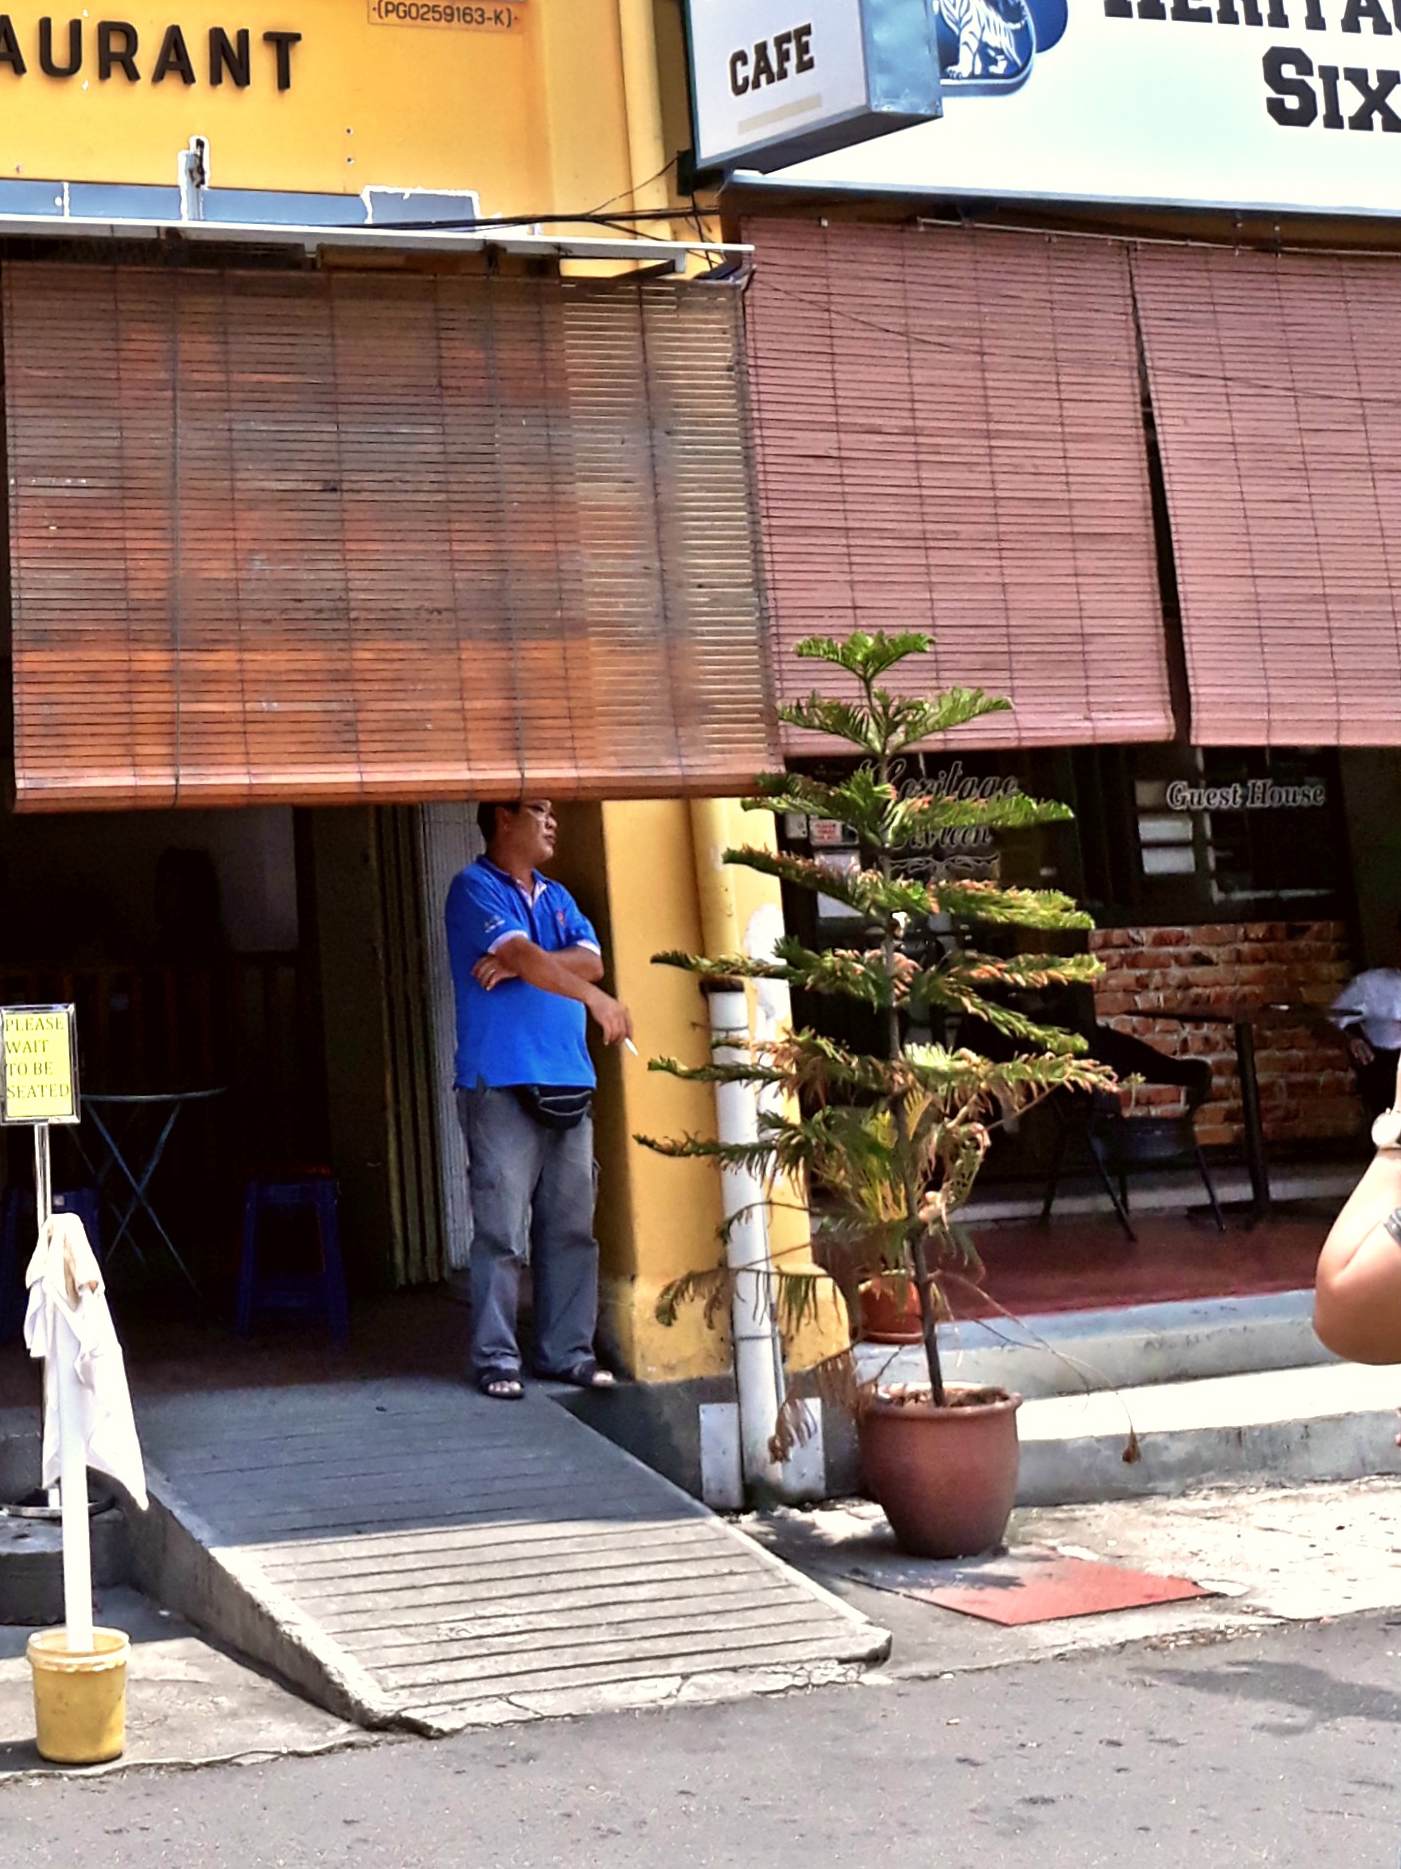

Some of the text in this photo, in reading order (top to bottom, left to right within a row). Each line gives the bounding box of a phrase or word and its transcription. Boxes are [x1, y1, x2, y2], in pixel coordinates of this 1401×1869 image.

[728, 22, 815, 98] CAFE
[1166, 778, 1327, 811] Guest House
[5, 1016, 65, 1032] PLEASE
[5, 1039, 49, 1054] WAIT
[6, 1060, 54, 1077] TO BE
[6, 1083, 70, 1100] SEATED
